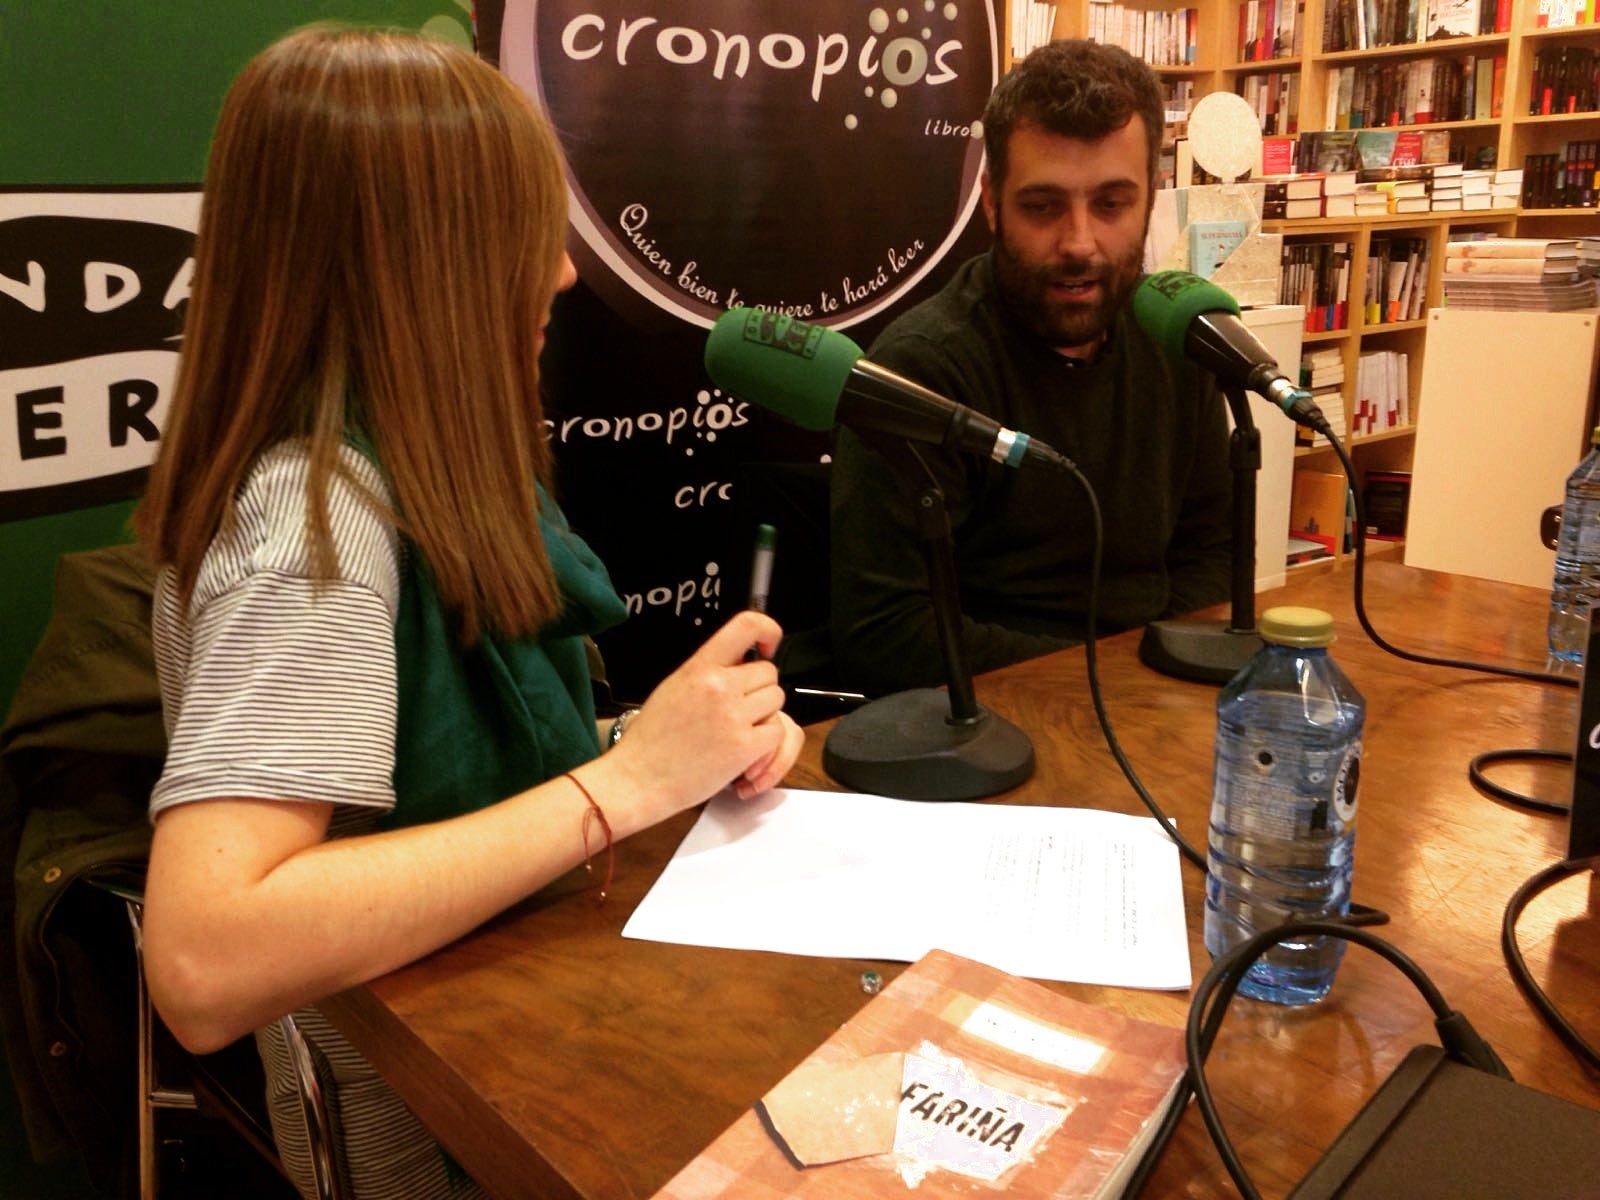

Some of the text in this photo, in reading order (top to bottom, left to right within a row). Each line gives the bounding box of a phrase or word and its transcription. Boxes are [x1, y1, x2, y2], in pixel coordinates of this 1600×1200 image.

[561, 12, 962, 102] cronopios
[924, 118, 975, 138] libro
[620, 203, 672, 275] Quien
[678, 261, 719, 304] bien
[820, 291, 839, 313] te
[842, 265, 888, 305] hará
[887, 238, 924, 273] leer
[899, 1081, 1025, 1152] FARIÑA
